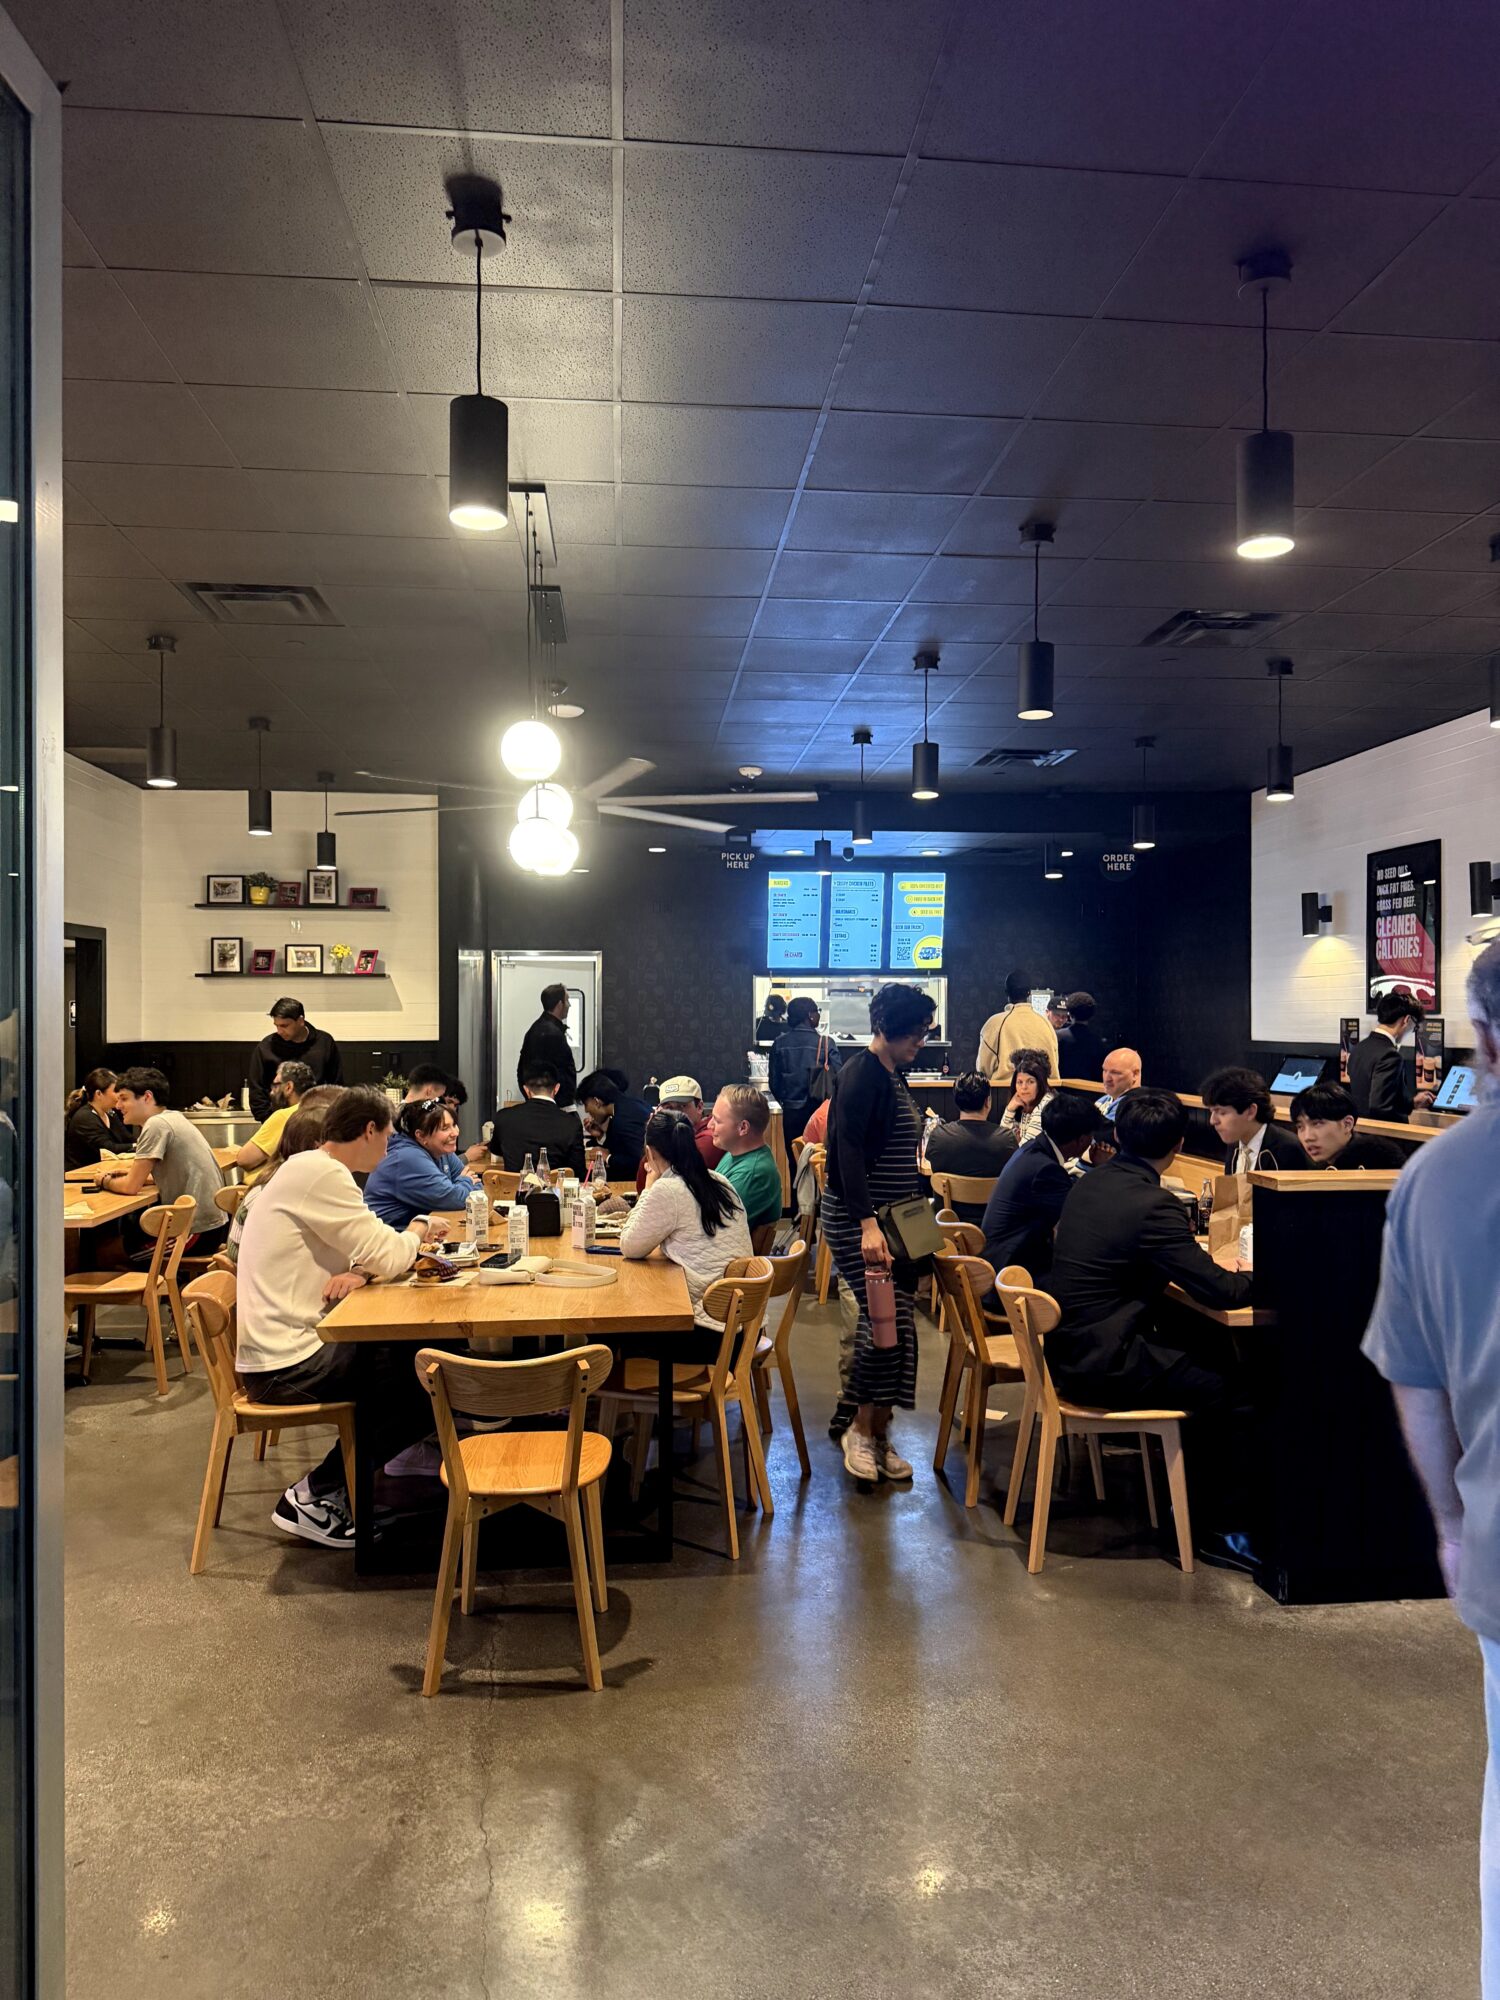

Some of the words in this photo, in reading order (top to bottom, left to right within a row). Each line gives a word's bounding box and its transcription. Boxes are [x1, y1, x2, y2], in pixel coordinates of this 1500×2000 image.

[721, 852, 741, 861] PICK
[743, 852, 755, 861] UP
[1102, 853, 1135, 862] ORDER
[726, 861, 750, 869] HERE
[1107, 862, 1132, 871] HERE
[1376, 869, 1384, 881] NO
[1384, 866, 1397, 879] SEED
[1376, 882, 1390, 896] DUCK
[1389, 881, 1400, 894] FAT
[1400, 880, 1416, 893] FRIES.
[1376, 899, 1391, 912] GRASS
[1392, 897, 1402, 910] FED
[1403, 895, 1416, 908] BEEF.
[1375, 913, 1417, 938] CLEANER
[1375, 935, 1422, 960] CALORIES.
